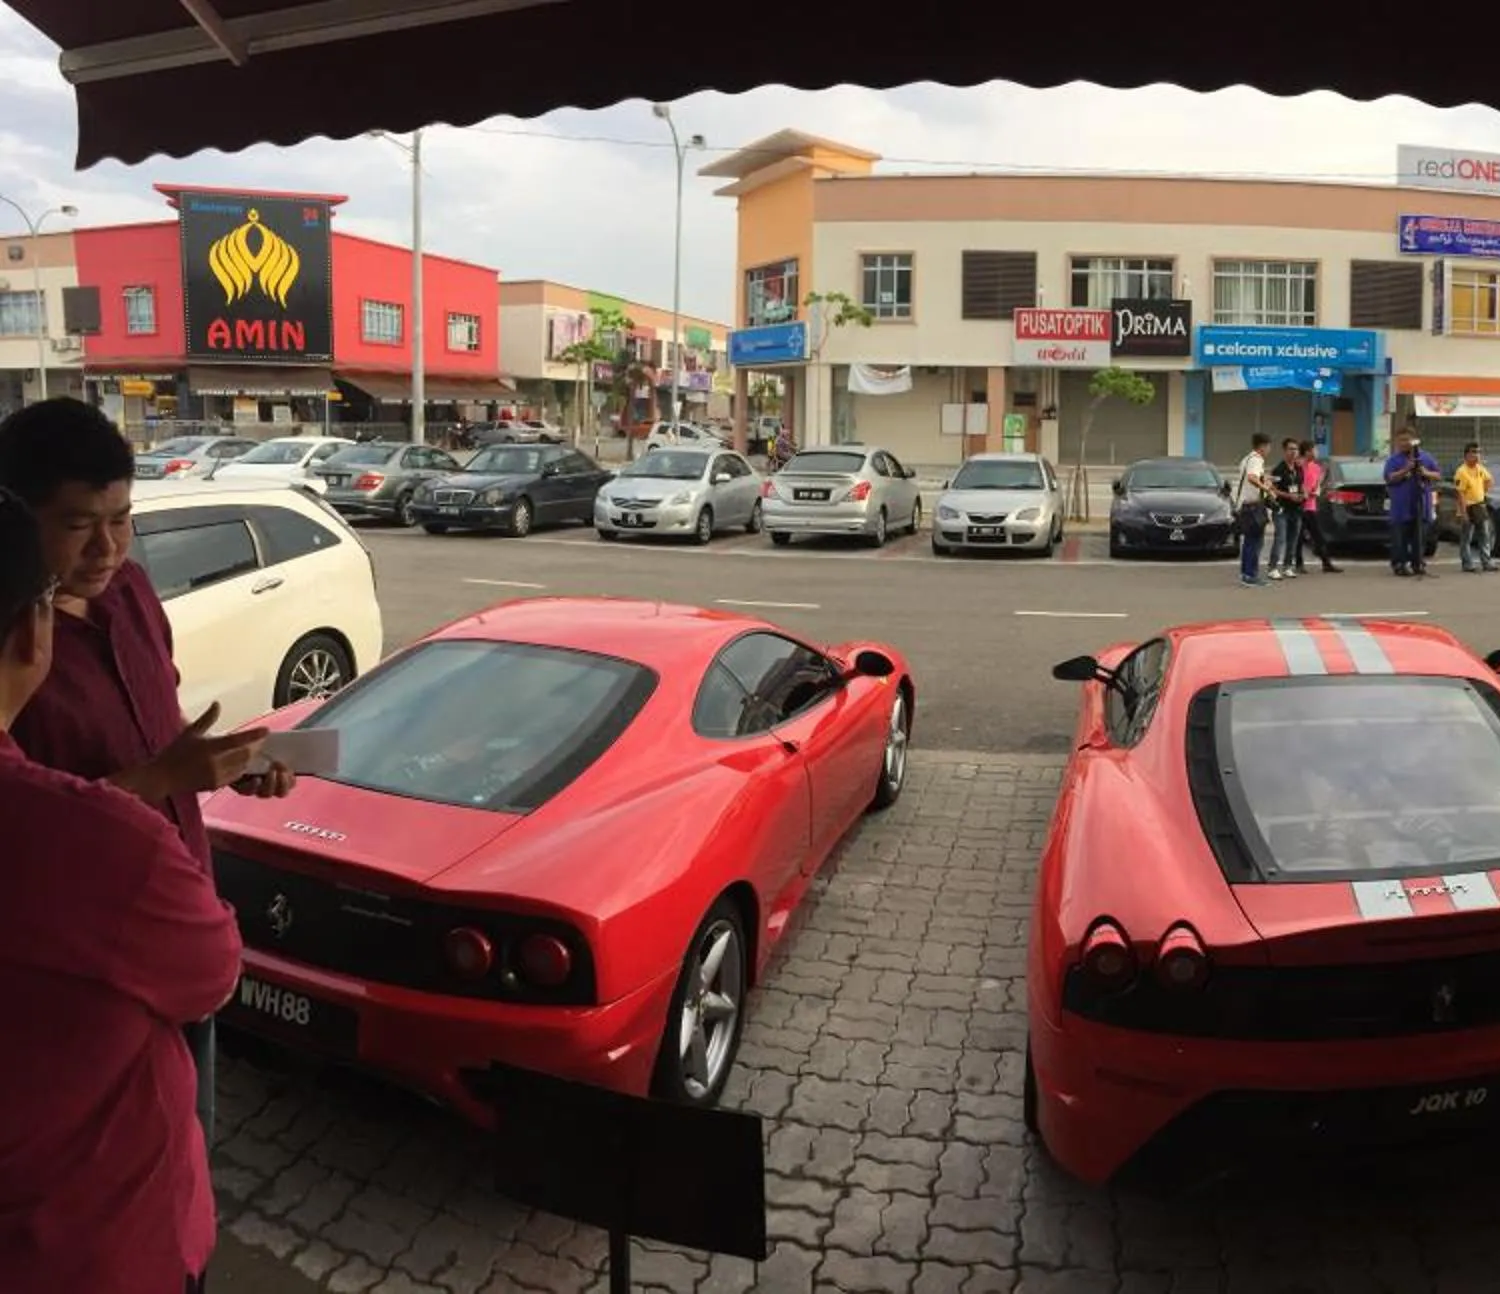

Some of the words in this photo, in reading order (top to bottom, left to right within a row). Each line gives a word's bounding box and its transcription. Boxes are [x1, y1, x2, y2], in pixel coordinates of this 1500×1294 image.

[208, 318, 305, 351] AMIN
[1216, 342, 1273, 356] celcom
[1277, 343, 1339, 358] xclusive
[1408, 1090, 1460, 1115] JQK
[1464, 1087, 1488, 1107] 10
